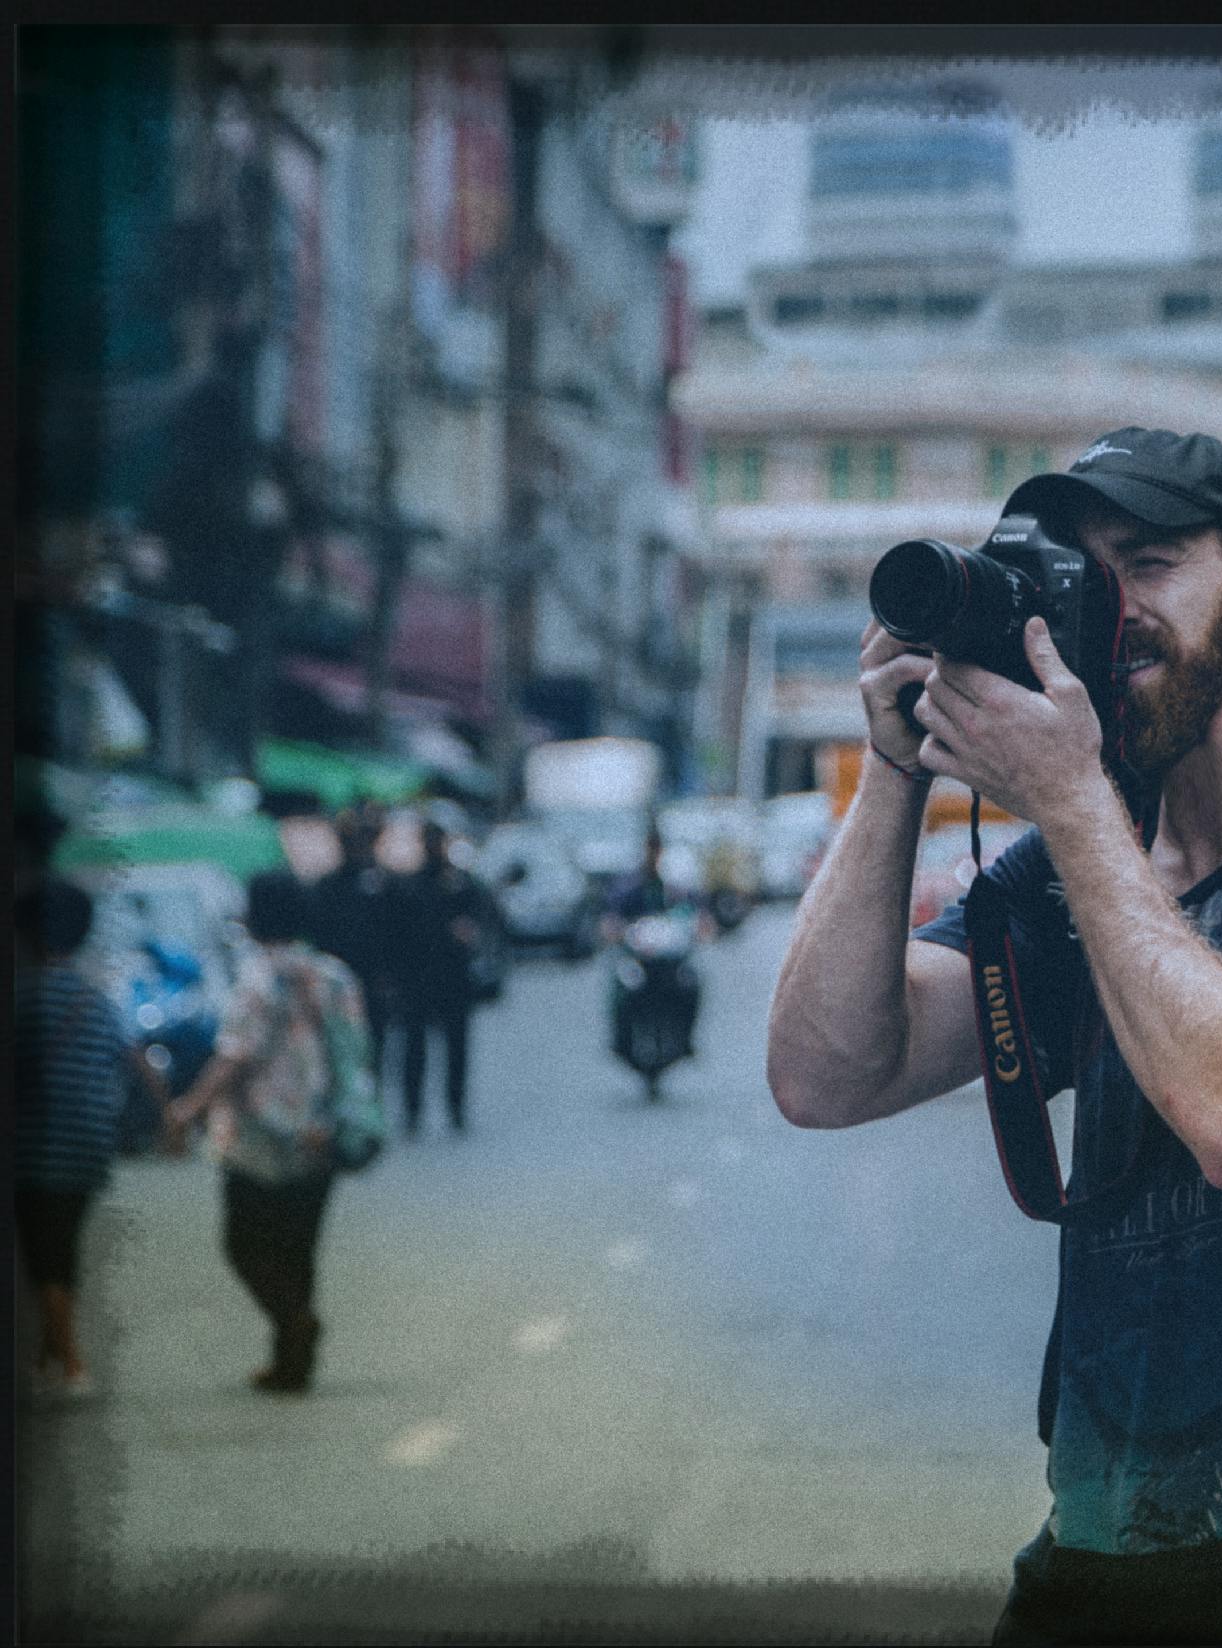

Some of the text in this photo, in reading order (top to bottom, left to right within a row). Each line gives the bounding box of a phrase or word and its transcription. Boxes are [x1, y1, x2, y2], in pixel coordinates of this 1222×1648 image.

[992, 533, 1028, 543] Canon
[1062, 577, 1072, 589] X
[983, 965, 1022, 1083] Canon
